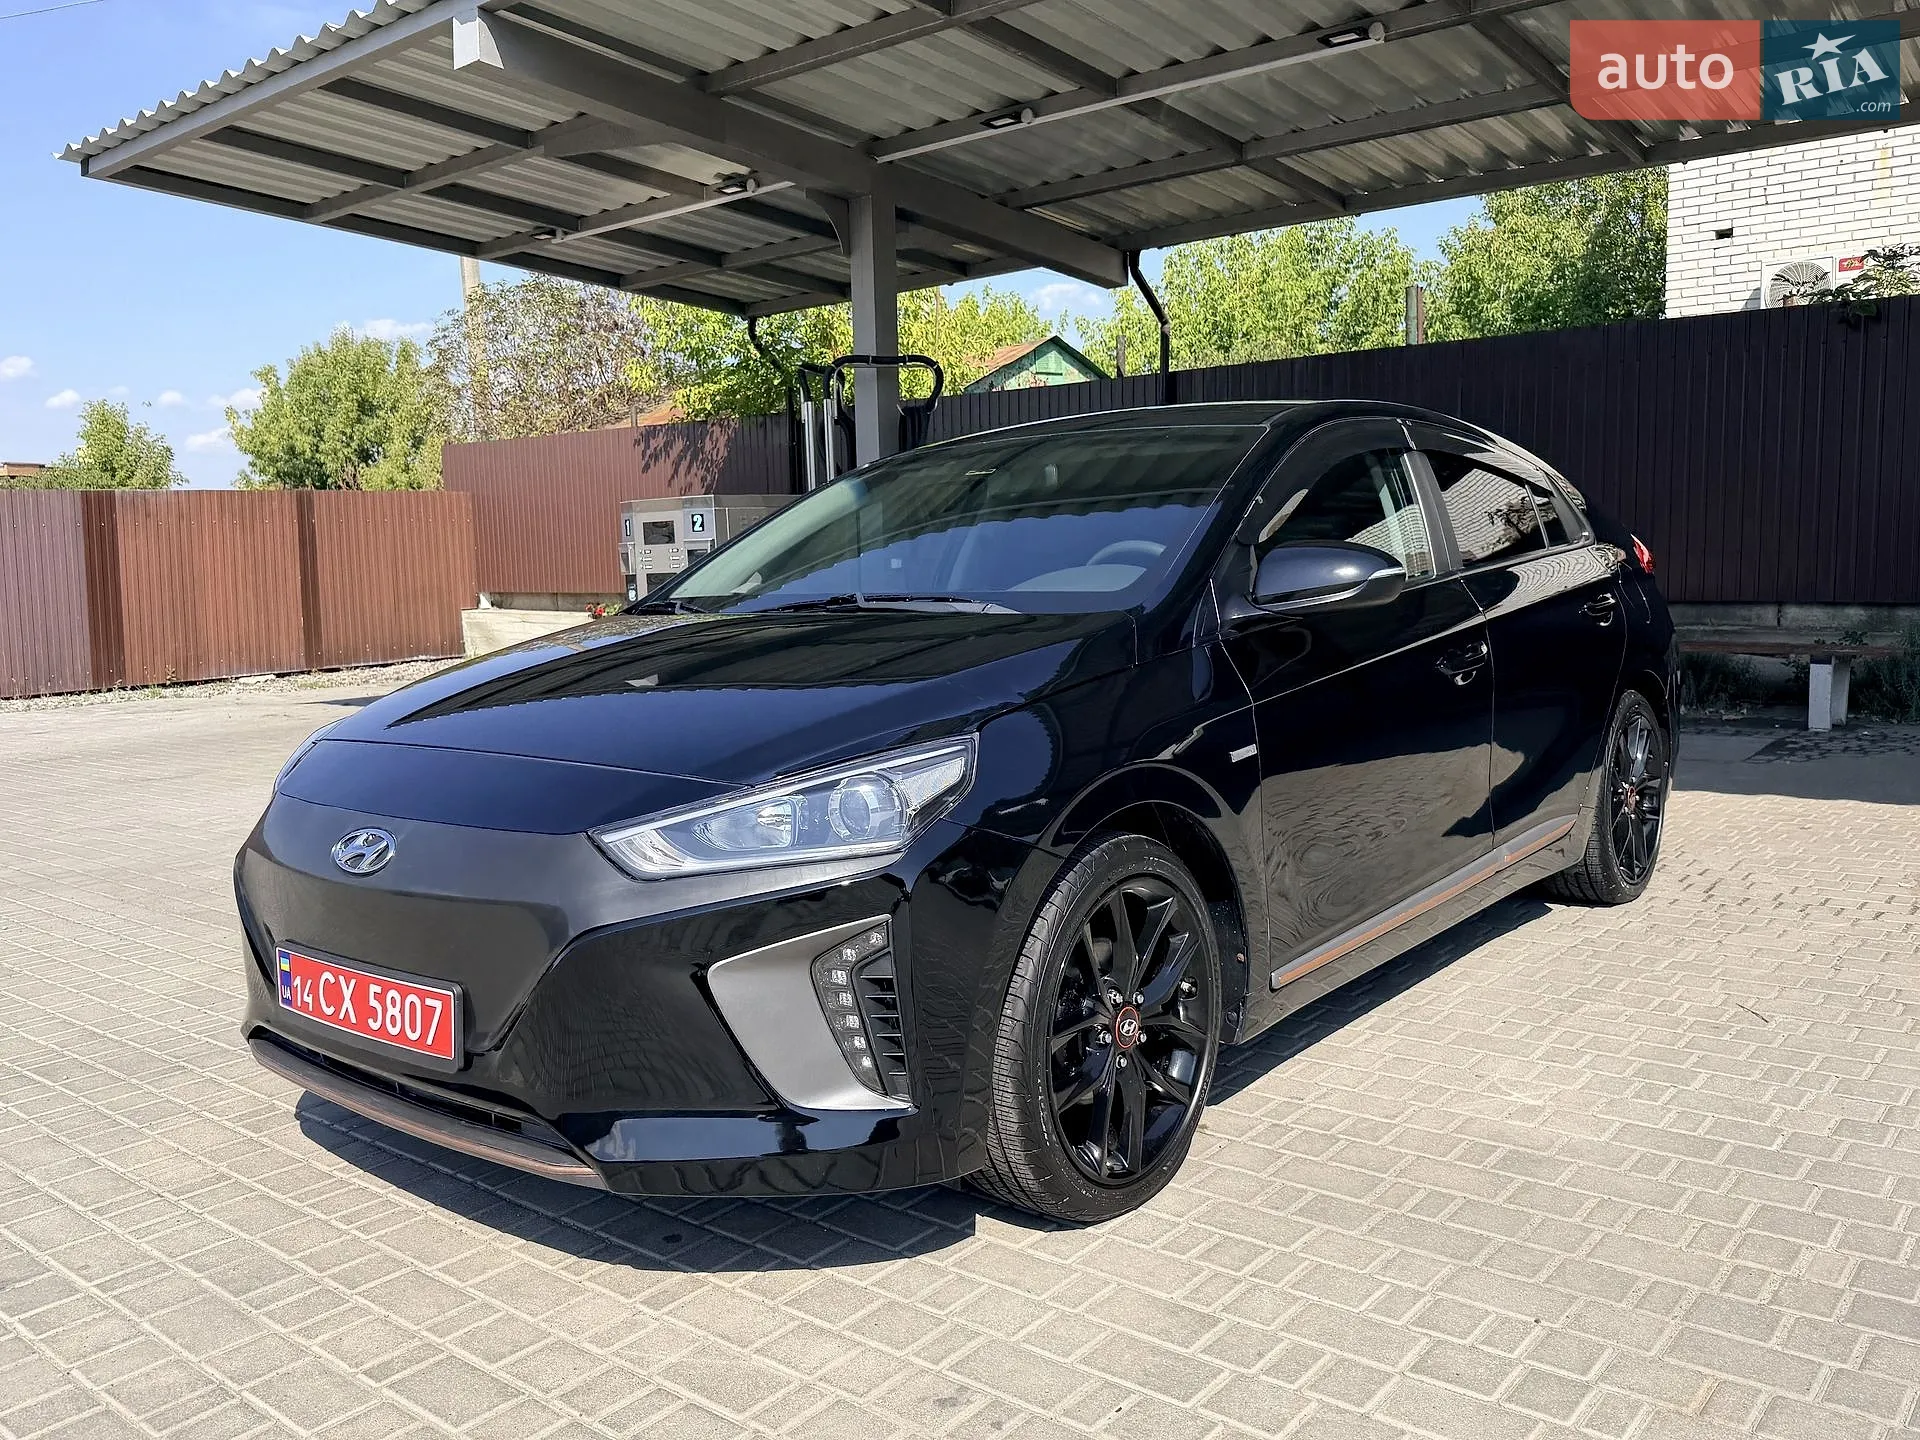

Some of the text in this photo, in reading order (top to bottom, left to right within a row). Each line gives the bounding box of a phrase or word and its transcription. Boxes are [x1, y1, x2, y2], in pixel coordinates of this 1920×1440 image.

[692, 514, 704, 532] 2
[282, 972, 443, 1046] UA 14 CX 5807
